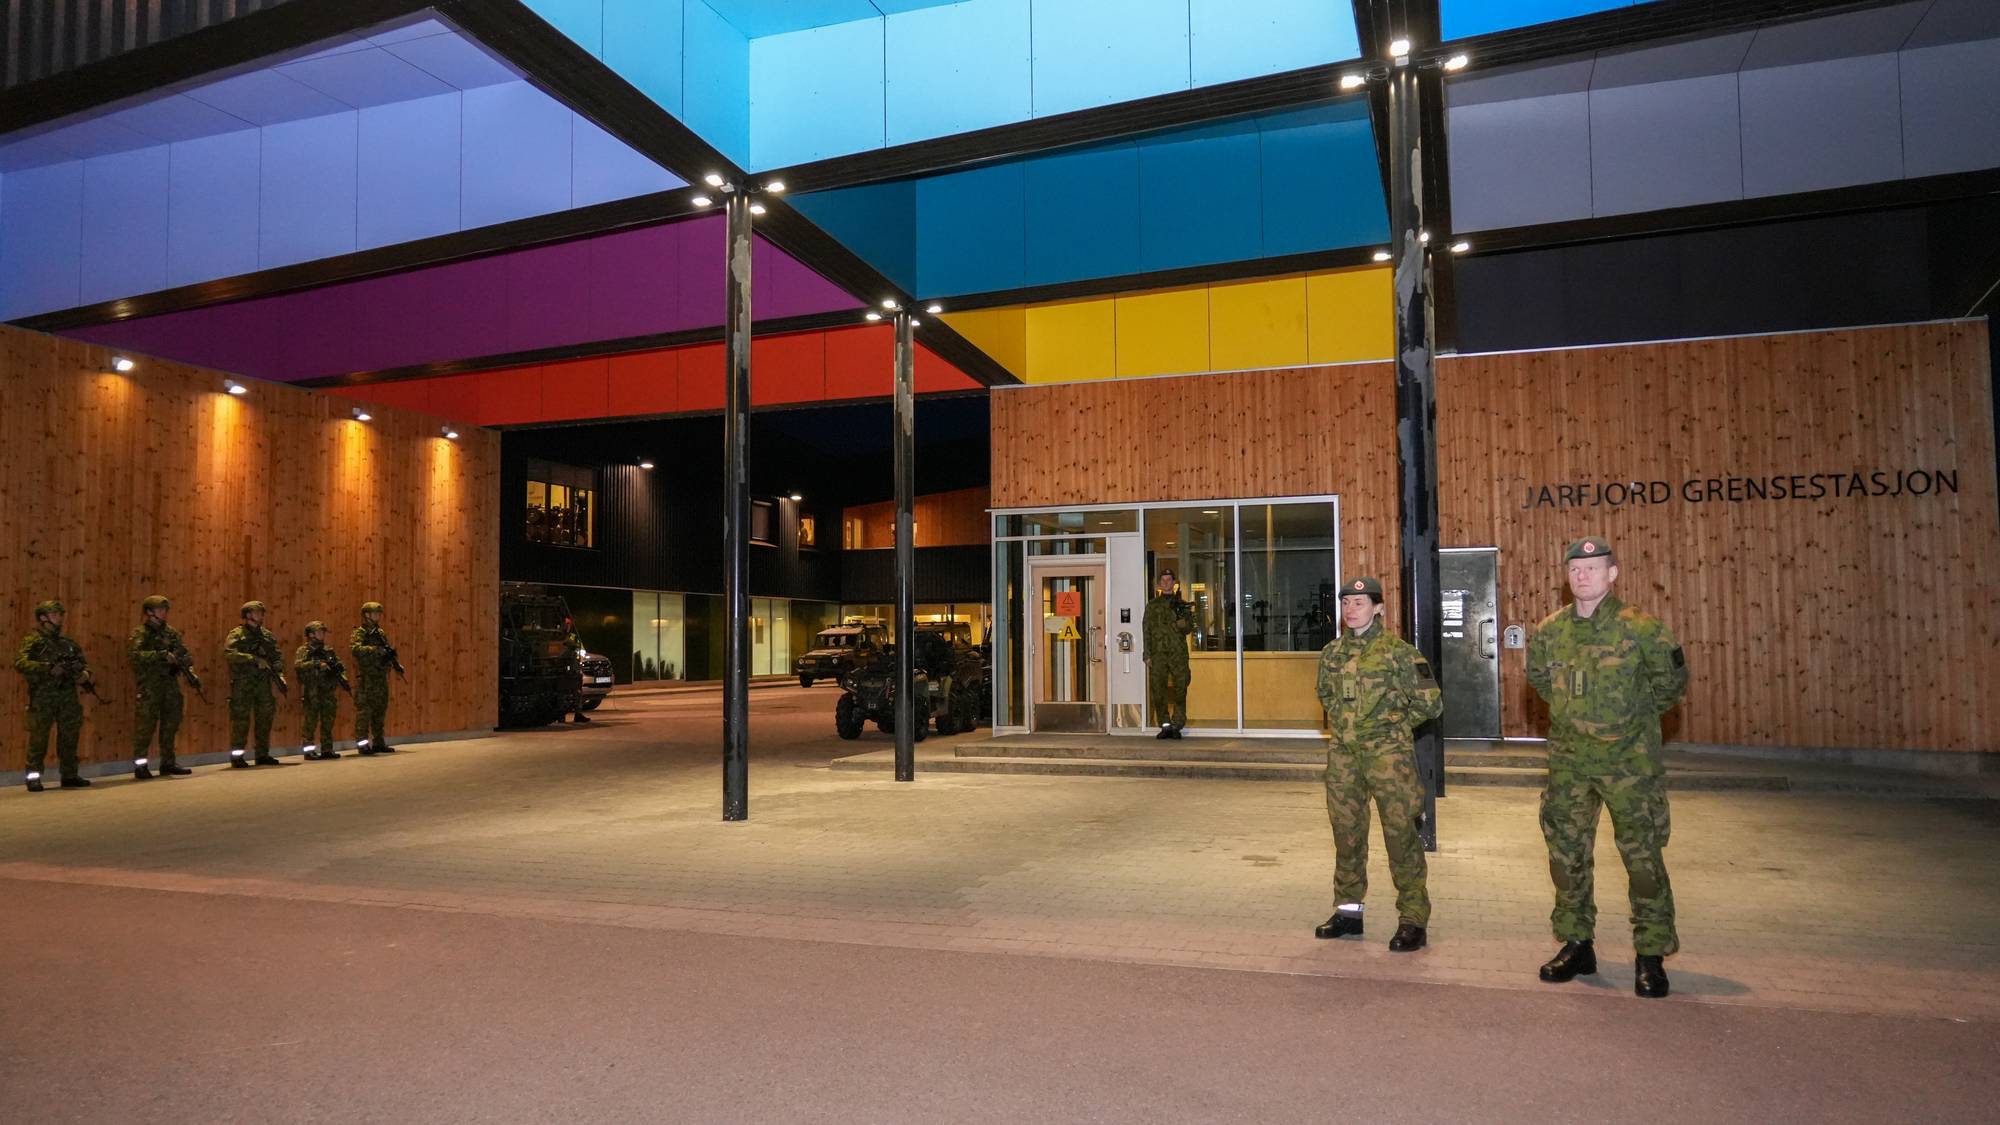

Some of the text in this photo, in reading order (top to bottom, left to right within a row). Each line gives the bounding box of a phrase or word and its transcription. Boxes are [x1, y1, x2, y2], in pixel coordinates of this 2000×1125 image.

[1521, 469, 1958, 509] JARFJORD GRENSESTASJON
[1064, 625, 1074, 637] A
